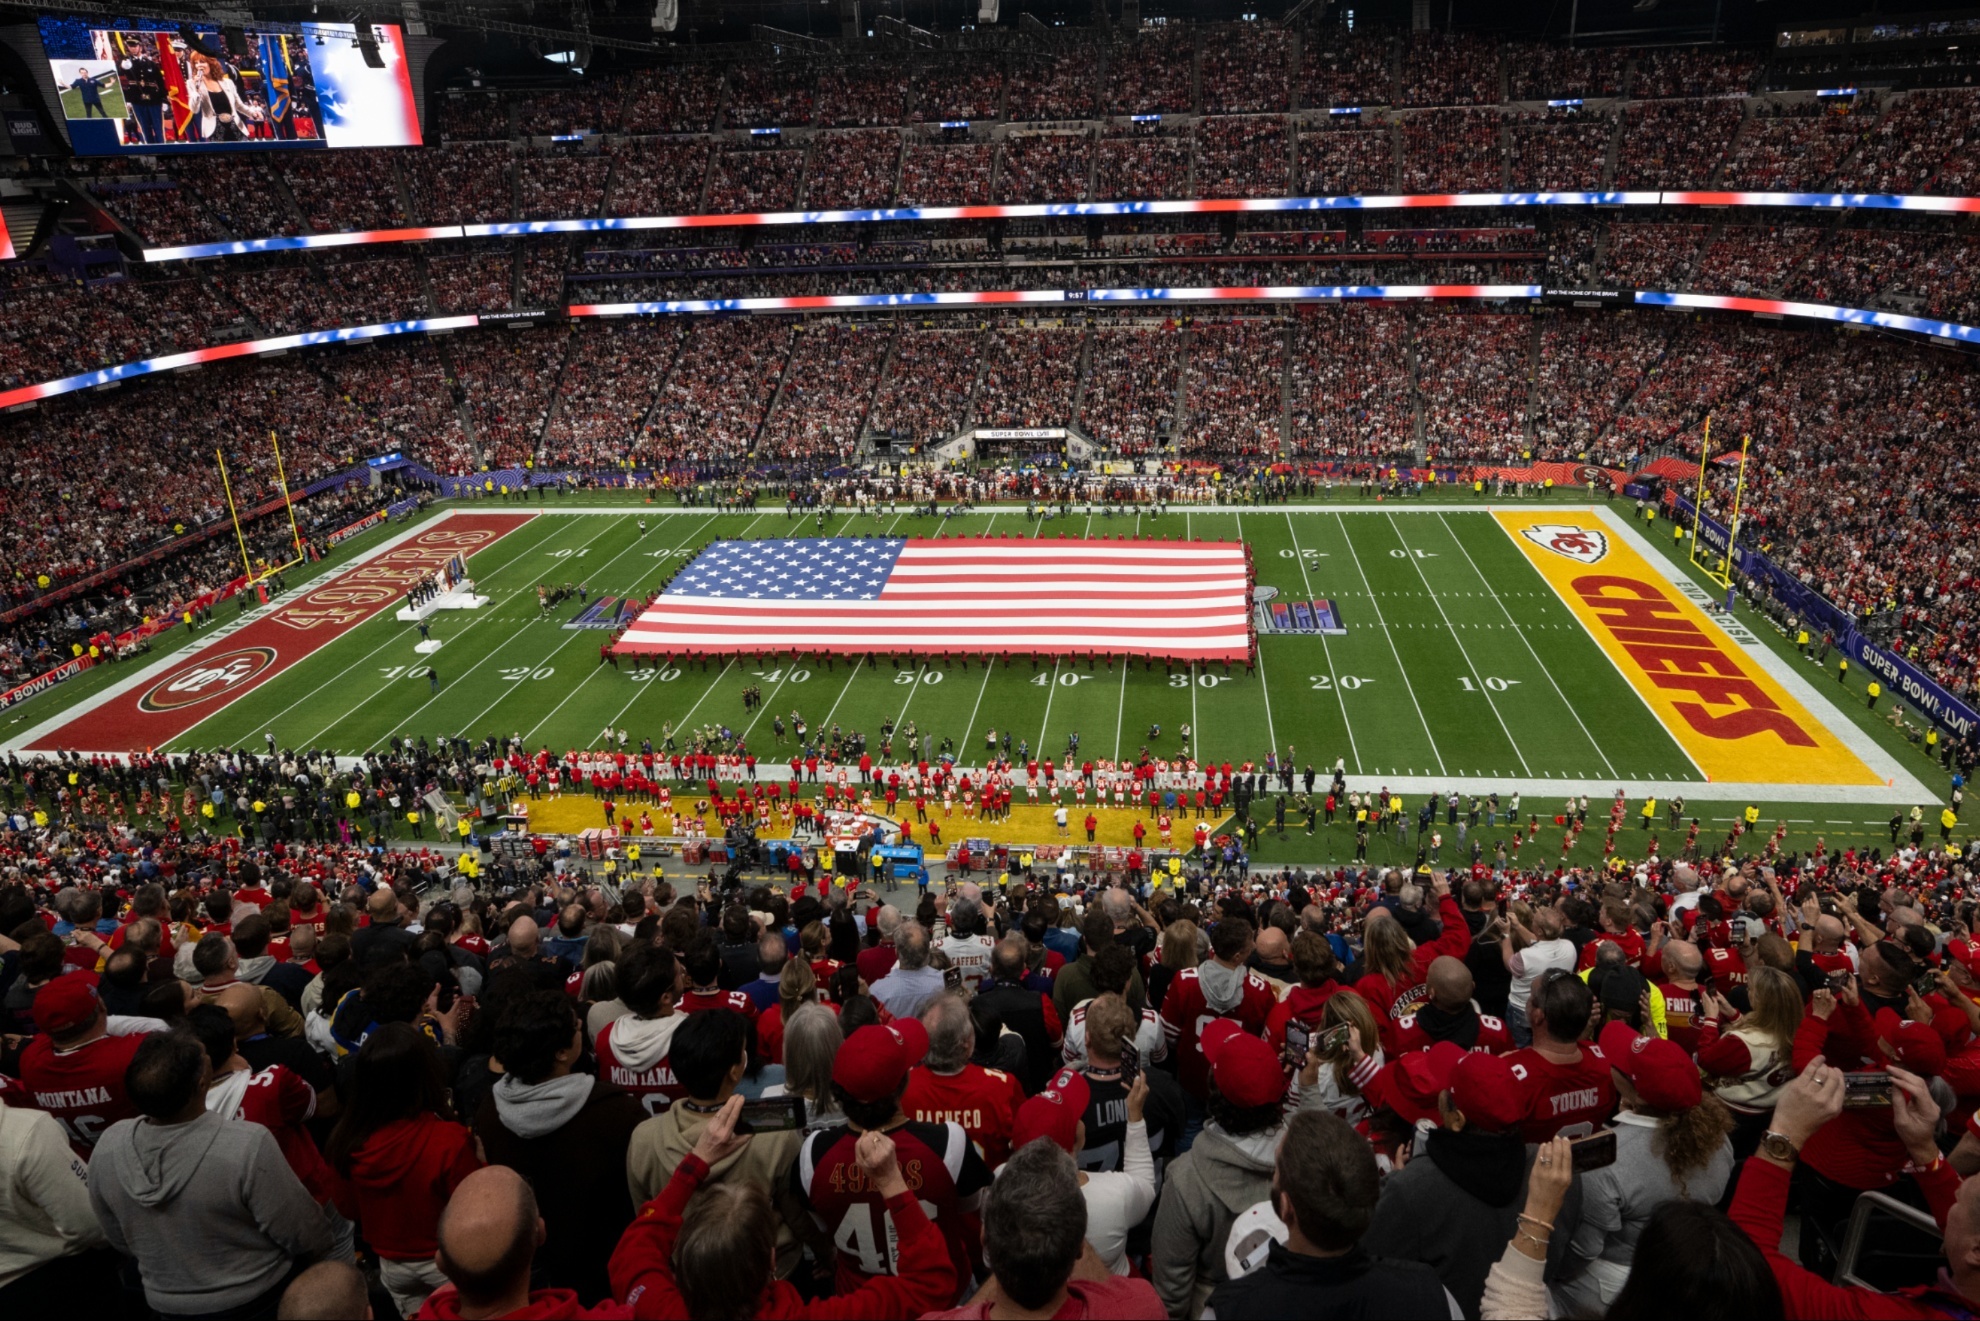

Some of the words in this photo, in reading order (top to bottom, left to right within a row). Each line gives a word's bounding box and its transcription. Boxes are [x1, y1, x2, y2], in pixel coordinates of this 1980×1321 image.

[343, 524, 364, 539] BOWL
[1704, 526, 1726, 550] BOWL
[270, 530, 496, 630] 49ERS
[1674, 581, 1708, 600] END
[177, 645, 204, 655] IT
[204, 608, 273, 640] TAKES
[273, 588, 310, 605] ALL
[309, 575, 333, 586] OF
[1570, 575, 1821, 748] CHIEFS
[13, 676, 55, 702] BOWL
[56, 661, 81, 680] LVIII
[501, 667, 555, 680] 20
[631, 668, 682, 681] 30
[761, 669, 811, 683] 40
[893, 670, 944, 685] 50
[1030, 672, 1080, 686] 40
[1169, 674, 1219, 688] 30
[1309, 675, 1362, 690] 20
[1457, 676, 1508, 691] 10
[1862, 645, 1899, 683] SUPER
[1902, 674, 1939, 715] BOWL
[1944, 706, 1972, 737] LVII
[1388, 982, 1428, 1021] CHIEF
[34, 1086, 112, 1109] MONTANA
[1550, 1086, 1599, 1116] YOUNG
[1096, 1098, 1128, 1127] LON
[829, 1159, 924, 1194] 49S
